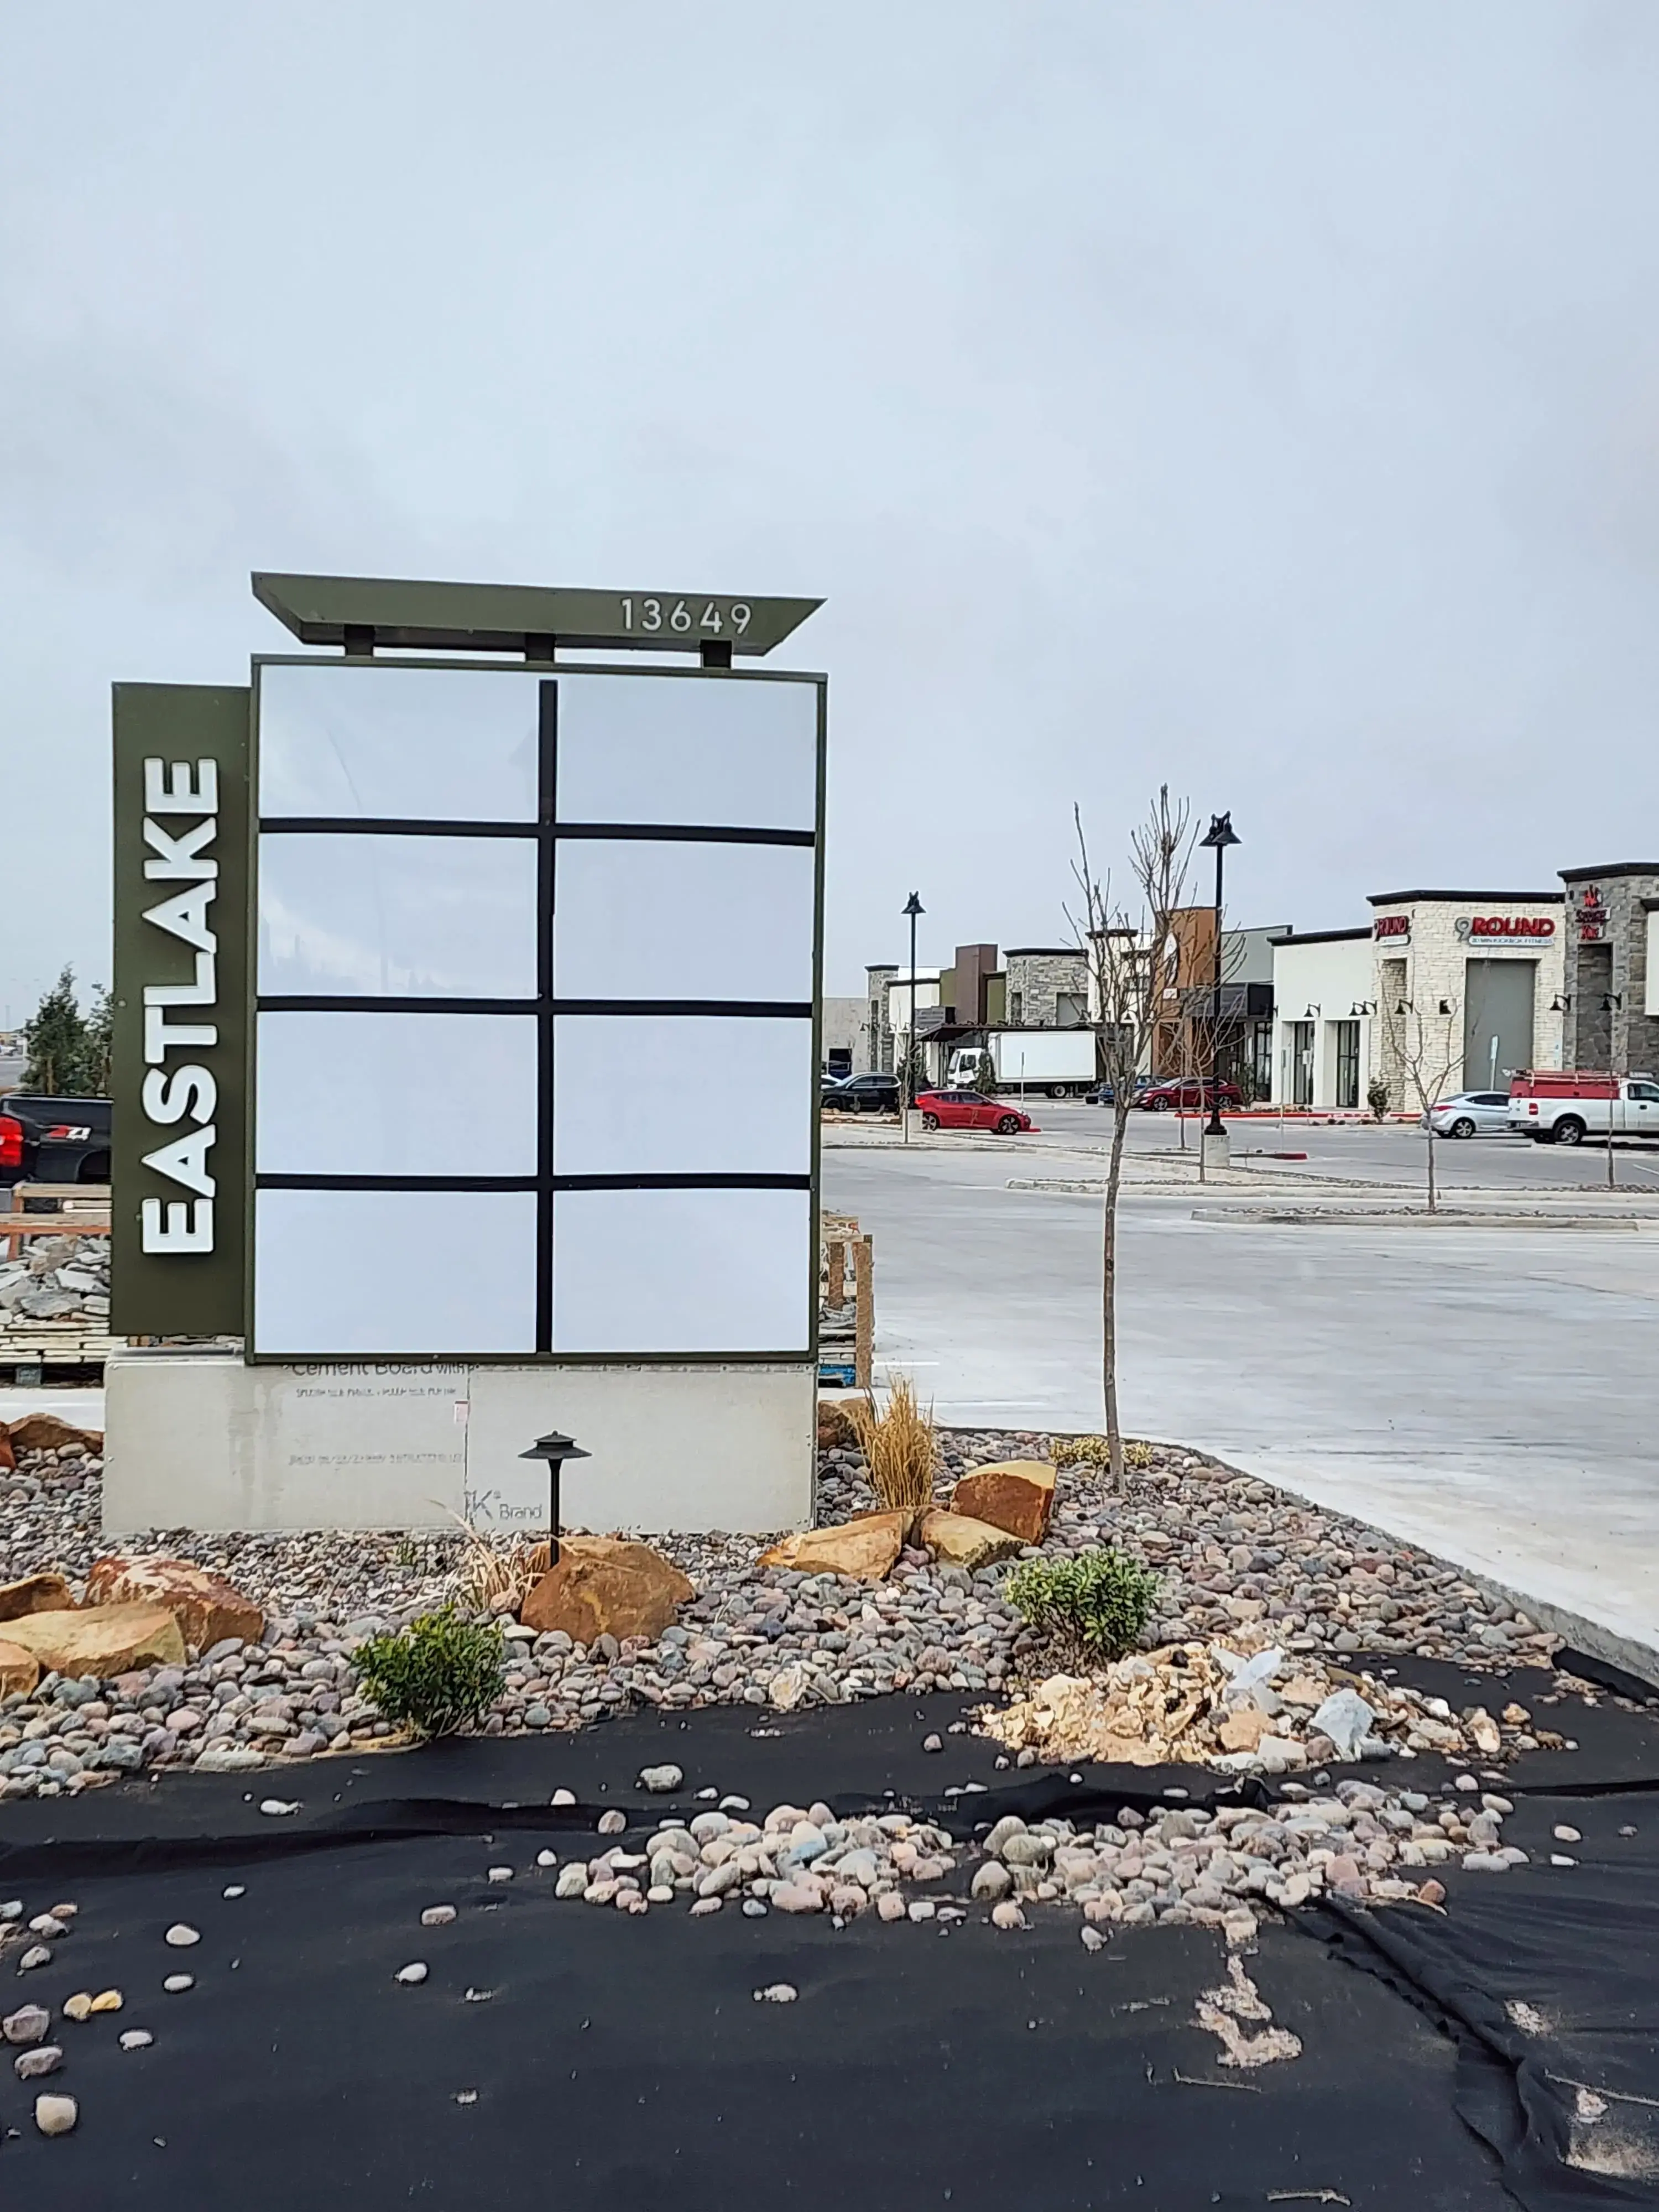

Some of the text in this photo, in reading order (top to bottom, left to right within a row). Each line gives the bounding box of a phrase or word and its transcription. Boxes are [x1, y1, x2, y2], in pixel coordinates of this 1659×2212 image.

[621, 598, 752, 635] 13649
[141, 757, 219, 1255] EASTLAKE
[499, 1504, 542, 1520] Brand
